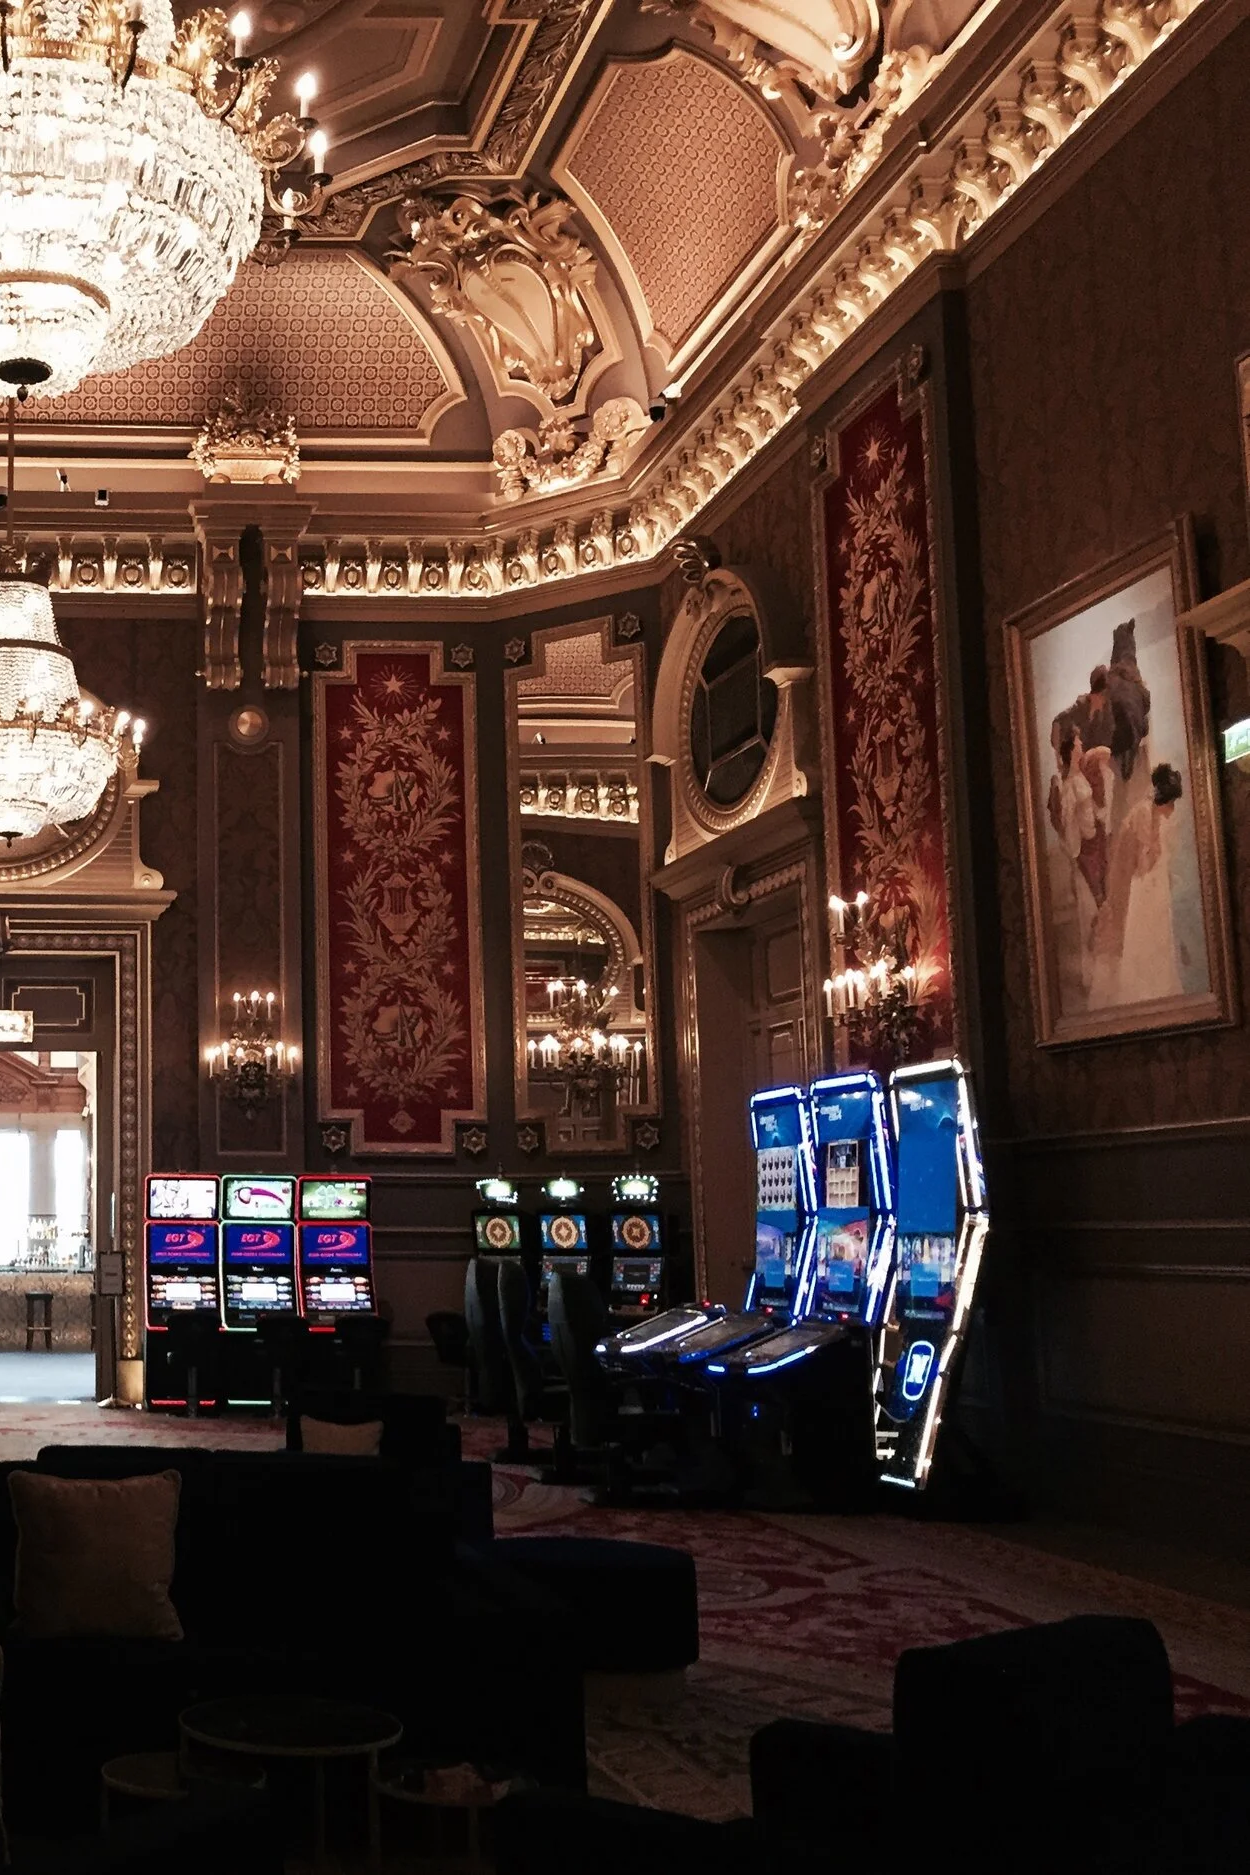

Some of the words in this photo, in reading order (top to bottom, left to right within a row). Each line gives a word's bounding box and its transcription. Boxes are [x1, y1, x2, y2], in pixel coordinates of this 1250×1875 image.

[165, 1233, 186, 1243] EGT
[241, 1233, 262, 1243] EGT
[317, 1233, 338, 1244] EGT
